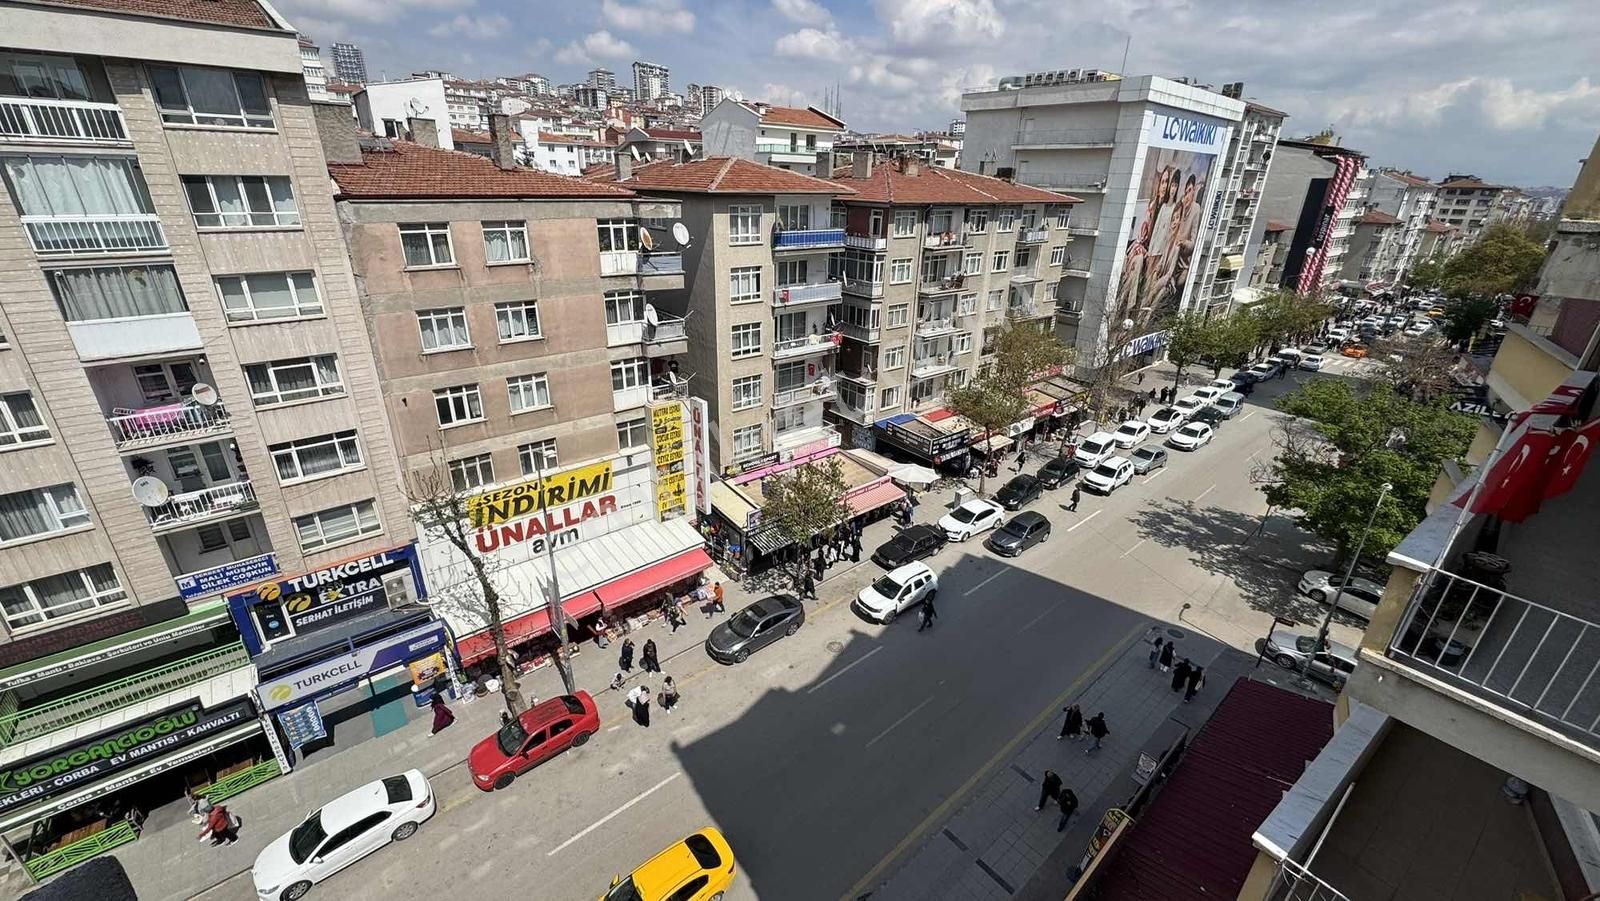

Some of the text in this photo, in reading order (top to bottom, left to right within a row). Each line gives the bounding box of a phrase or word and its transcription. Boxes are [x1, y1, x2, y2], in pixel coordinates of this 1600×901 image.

[475, 467, 611, 528] İNDİRİMİ
[482, 482, 539, 505] SEZON
[475, 494, 618, 553] ÜNALLAR
[532, 527, 579, 554] avm
[199, 561, 268, 583] MALİ MÜŞAVİR
[200, 577, 230, 590] DİLEK
[232, 566, 272, 581] COŞKUN
[288, 552, 394, 593] TURKCELL
[319, 577, 381, 605] EXTRA
[295, 595, 374, 627] SERHAT İLETİŞİM
[293, 660, 362, 690] TURKCELL
[14, 710, 197, 786] YORGANCIOĞLU
[110, 754, 126, 765] EV
[130, 737, 179, 758] MANTISI
[186, 712, 240, 737] KAHVALTI
